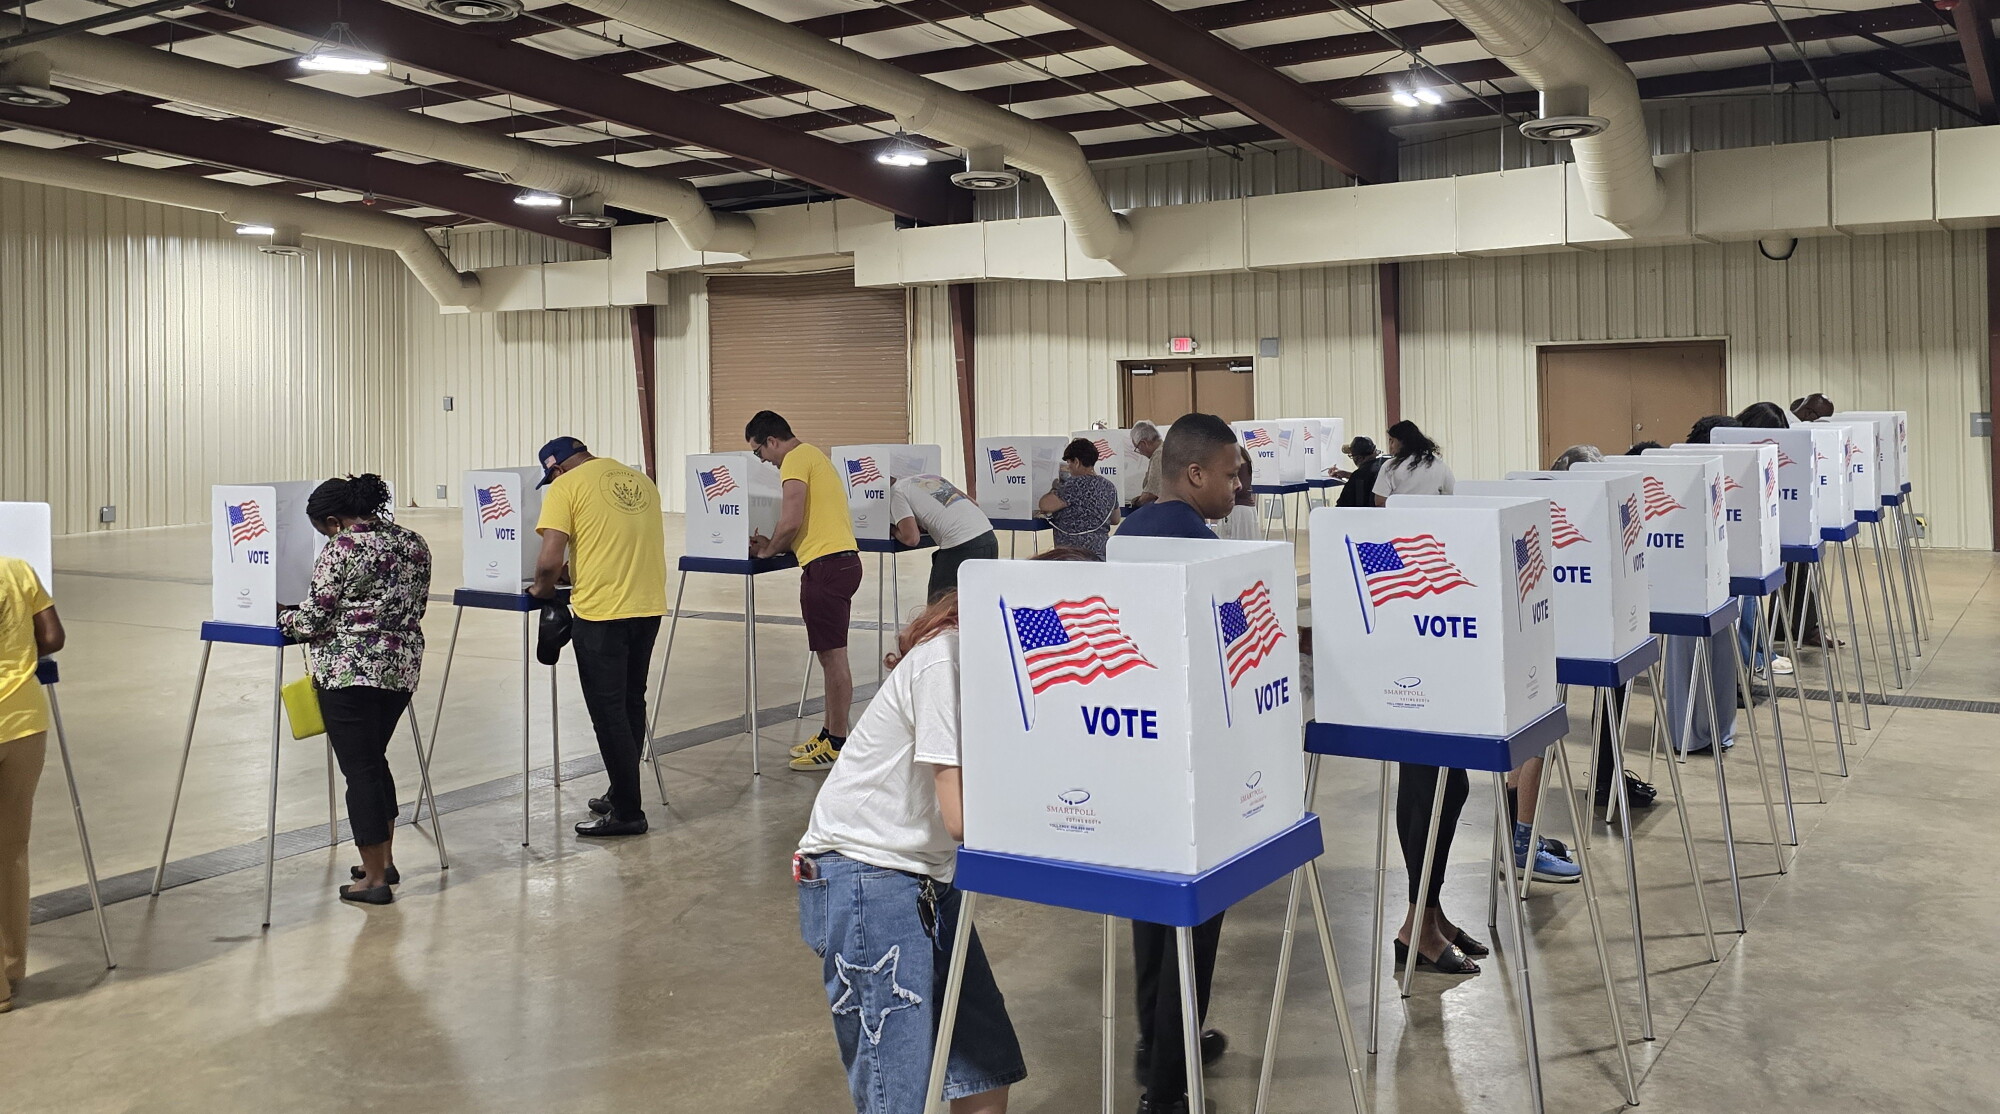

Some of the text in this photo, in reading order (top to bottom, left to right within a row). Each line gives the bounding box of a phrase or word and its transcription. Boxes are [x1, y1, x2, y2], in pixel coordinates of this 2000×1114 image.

[1100, 467, 1117, 475] VOTE
[1853, 464, 1863, 473] TE
[1007, 475, 1026, 484] VOTE
[865, 490, 885, 499] VOTE
[1779, 489, 1798, 500] TE
[720, 504, 740, 515] VOTE
[1726, 509, 1742, 521] TE
[495, 528, 515, 540] VOTE
[248, 550, 269, 565] VOTE
[1553, 565, 1592, 583] OTE
[1532, 598, 1549, 625] VOTE
[1413, 614, 1478, 638] VOTE
[1255, 676, 1289, 715] VOTE
[1384, 689, 1425, 697] SMARTPOLL
[1081, 705, 1158, 740] VOTE
[1046, 805, 1096, 817] SMARTPOLL
